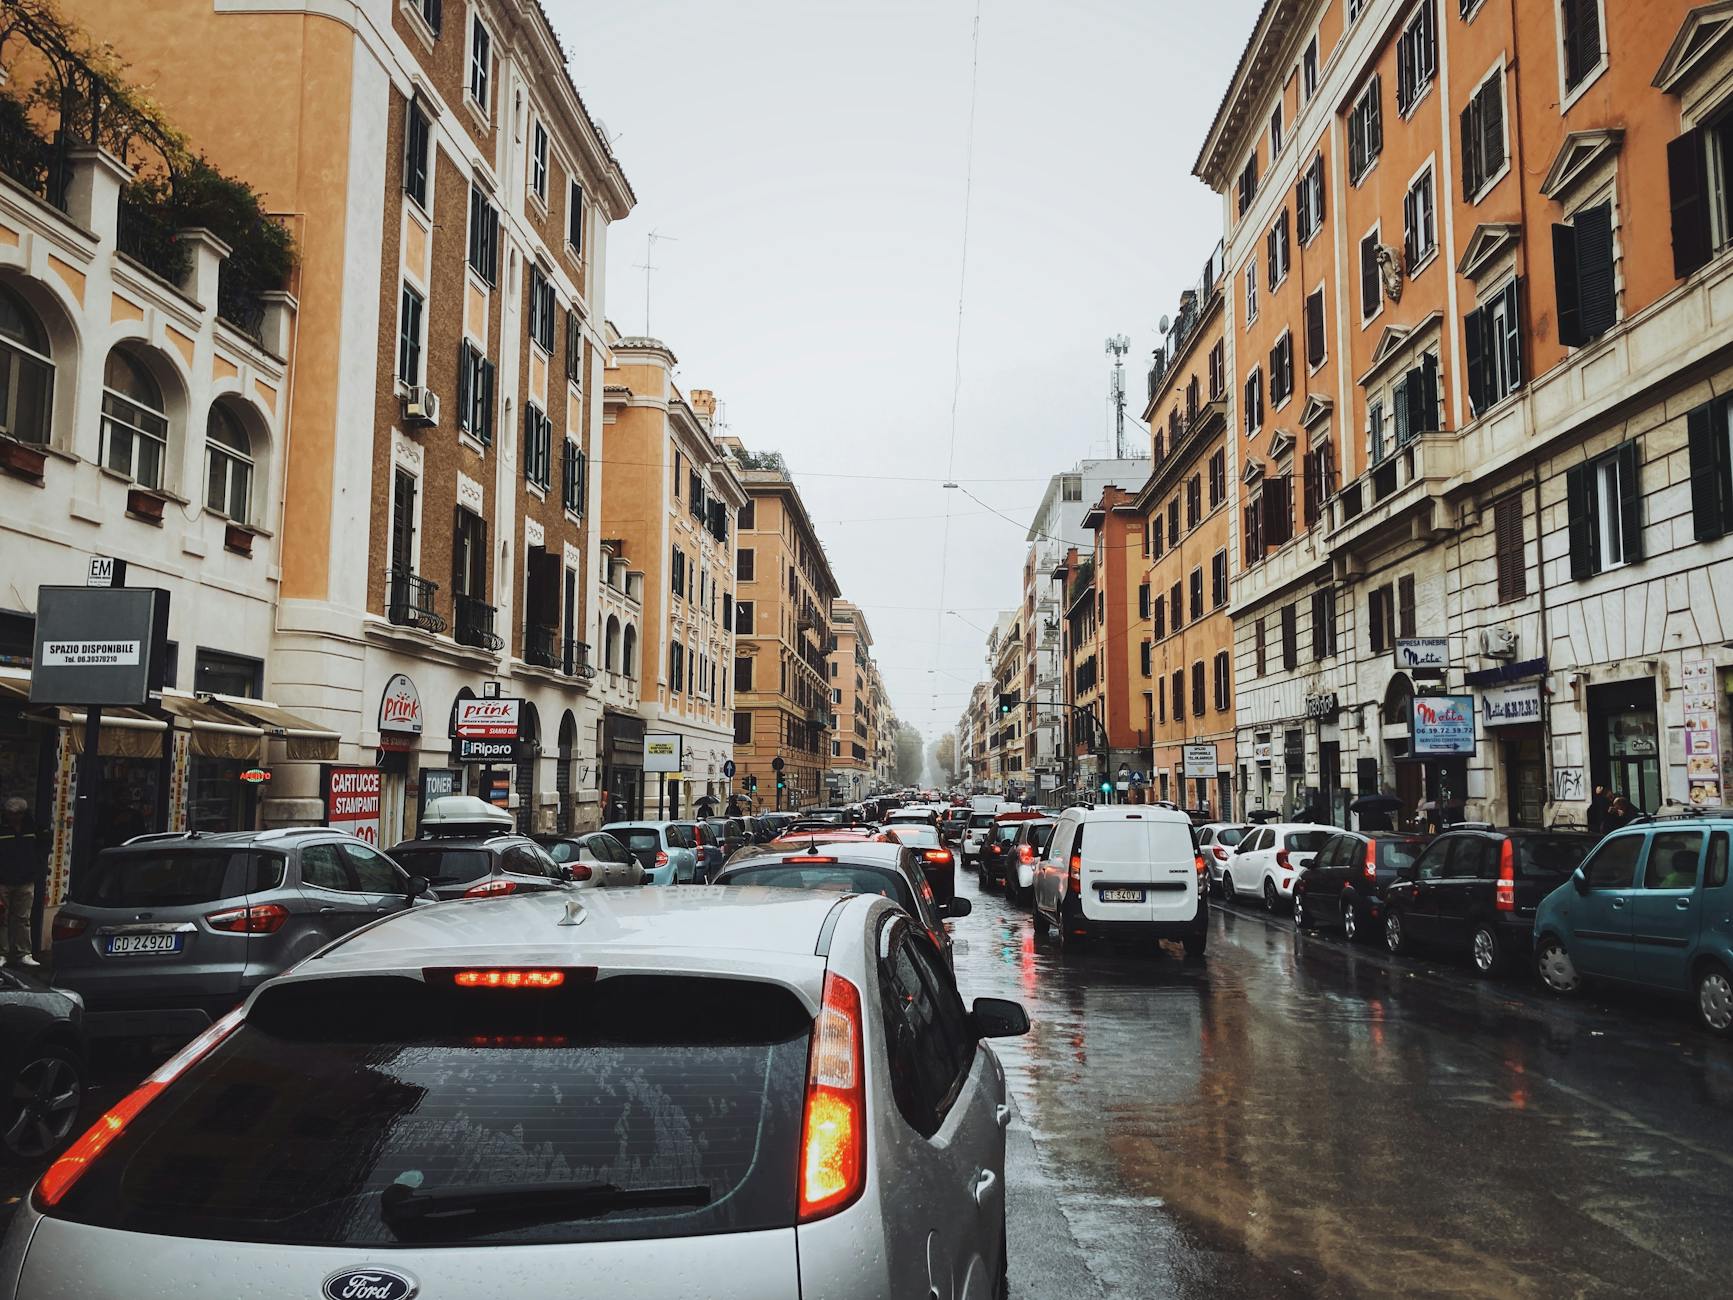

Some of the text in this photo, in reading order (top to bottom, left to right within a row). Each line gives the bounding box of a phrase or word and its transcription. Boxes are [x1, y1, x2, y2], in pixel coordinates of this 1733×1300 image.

[91, 560, 111, 576] EM
[49, 644, 134, 654] SPAZIO DISPONIBILE
[384, 696, 420, 721] prink
[464, 703, 513, 719] prink
[470, 742, 512, 757] iRiparo
[240, 771, 271, 780] APERTO
[332, 773, 380, 793] CARTUCCE
[426, 777, 452, 793] TONER
[335, 796, 379, 815] STAMPANTI
[114, 935, 173, 951] GD 249ZD
[342, 1275, 393, 1299] Ford
